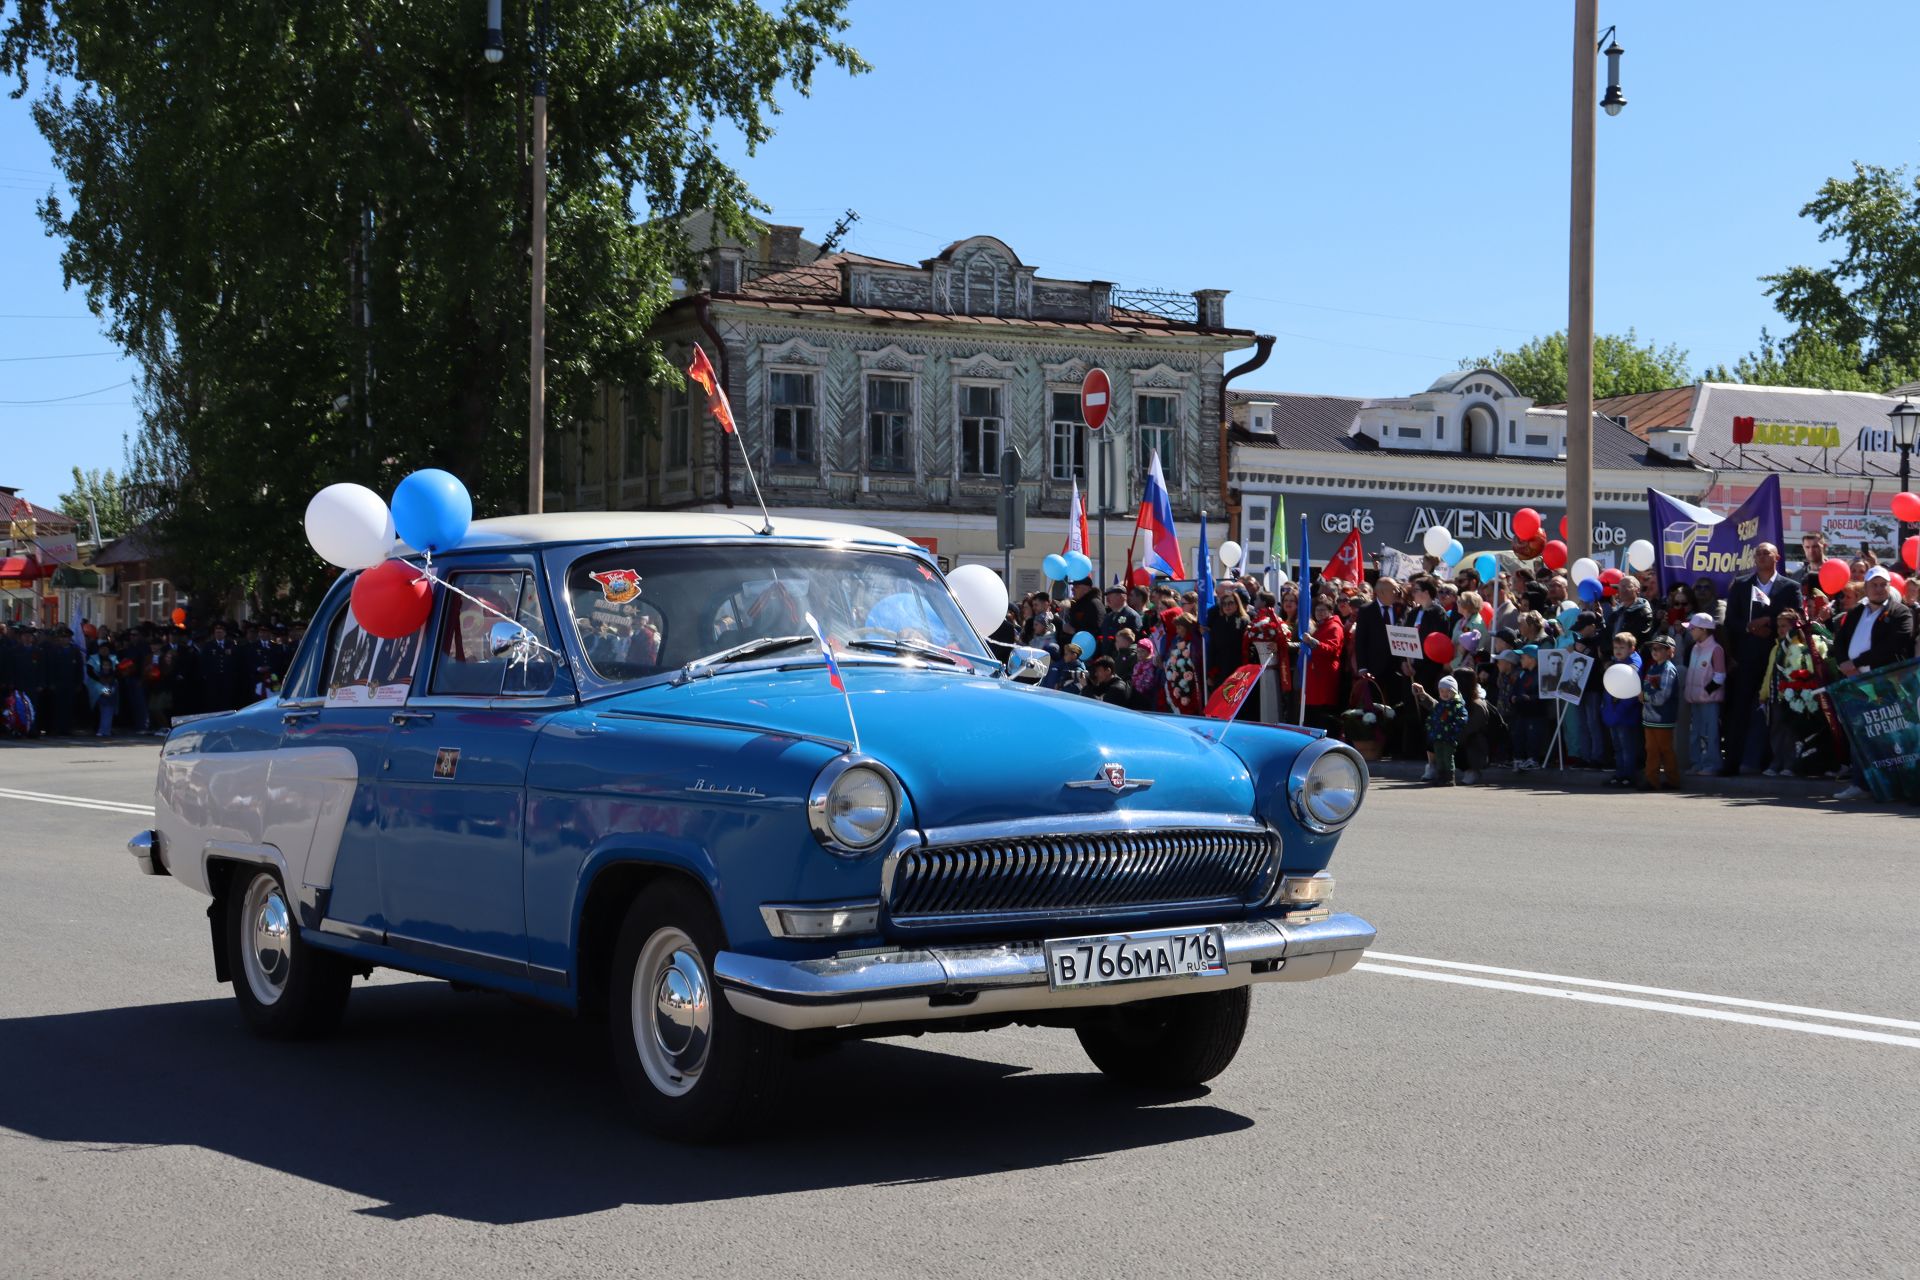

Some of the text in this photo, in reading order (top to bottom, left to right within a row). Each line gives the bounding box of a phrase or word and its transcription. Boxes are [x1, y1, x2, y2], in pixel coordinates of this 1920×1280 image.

[1321, 507, 1546, 544] café AVENU
[1863, 702, 1903, 724] БЕЛЫЙ
[1865, 718, 1909, 738] КРЕМЛЬ
[1174, 934, 1218, 962] 716
[1187, 960, 1208, 972] RUS
